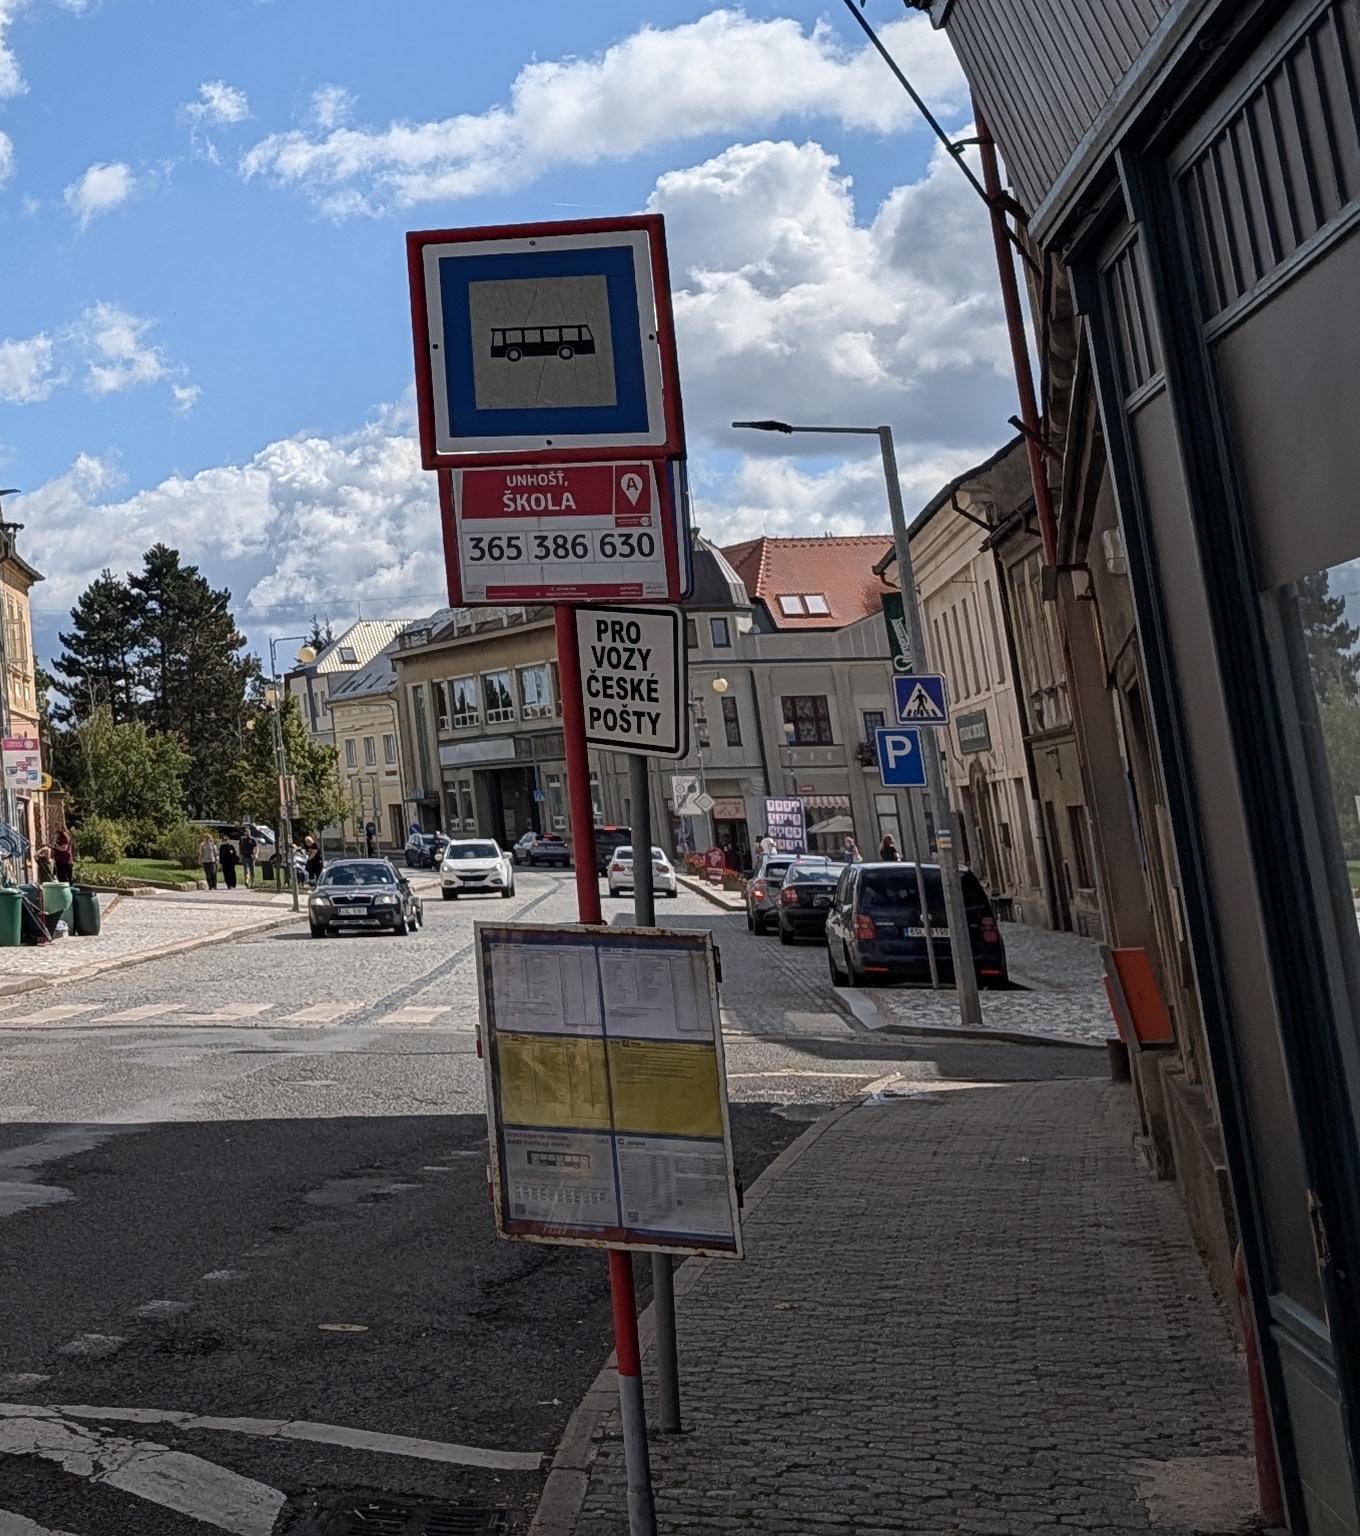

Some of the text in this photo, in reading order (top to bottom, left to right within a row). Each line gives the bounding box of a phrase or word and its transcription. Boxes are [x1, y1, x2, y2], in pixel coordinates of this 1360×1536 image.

[506, 470, 569, 487] UNHOŠŤ,
[626, 477, 639, 491] A
[502, 490, 577, 512] ŠKOLA
[469, 532, 655, 562] 365 386 630
[596, 619, 641, 645] PRO
[590, 645, 652, 672] VOZY
[586, 668, 659, 703] ČESKÉ
[588, 703, 661, 736] POŠTY
[885, 735, 912, 769] P
